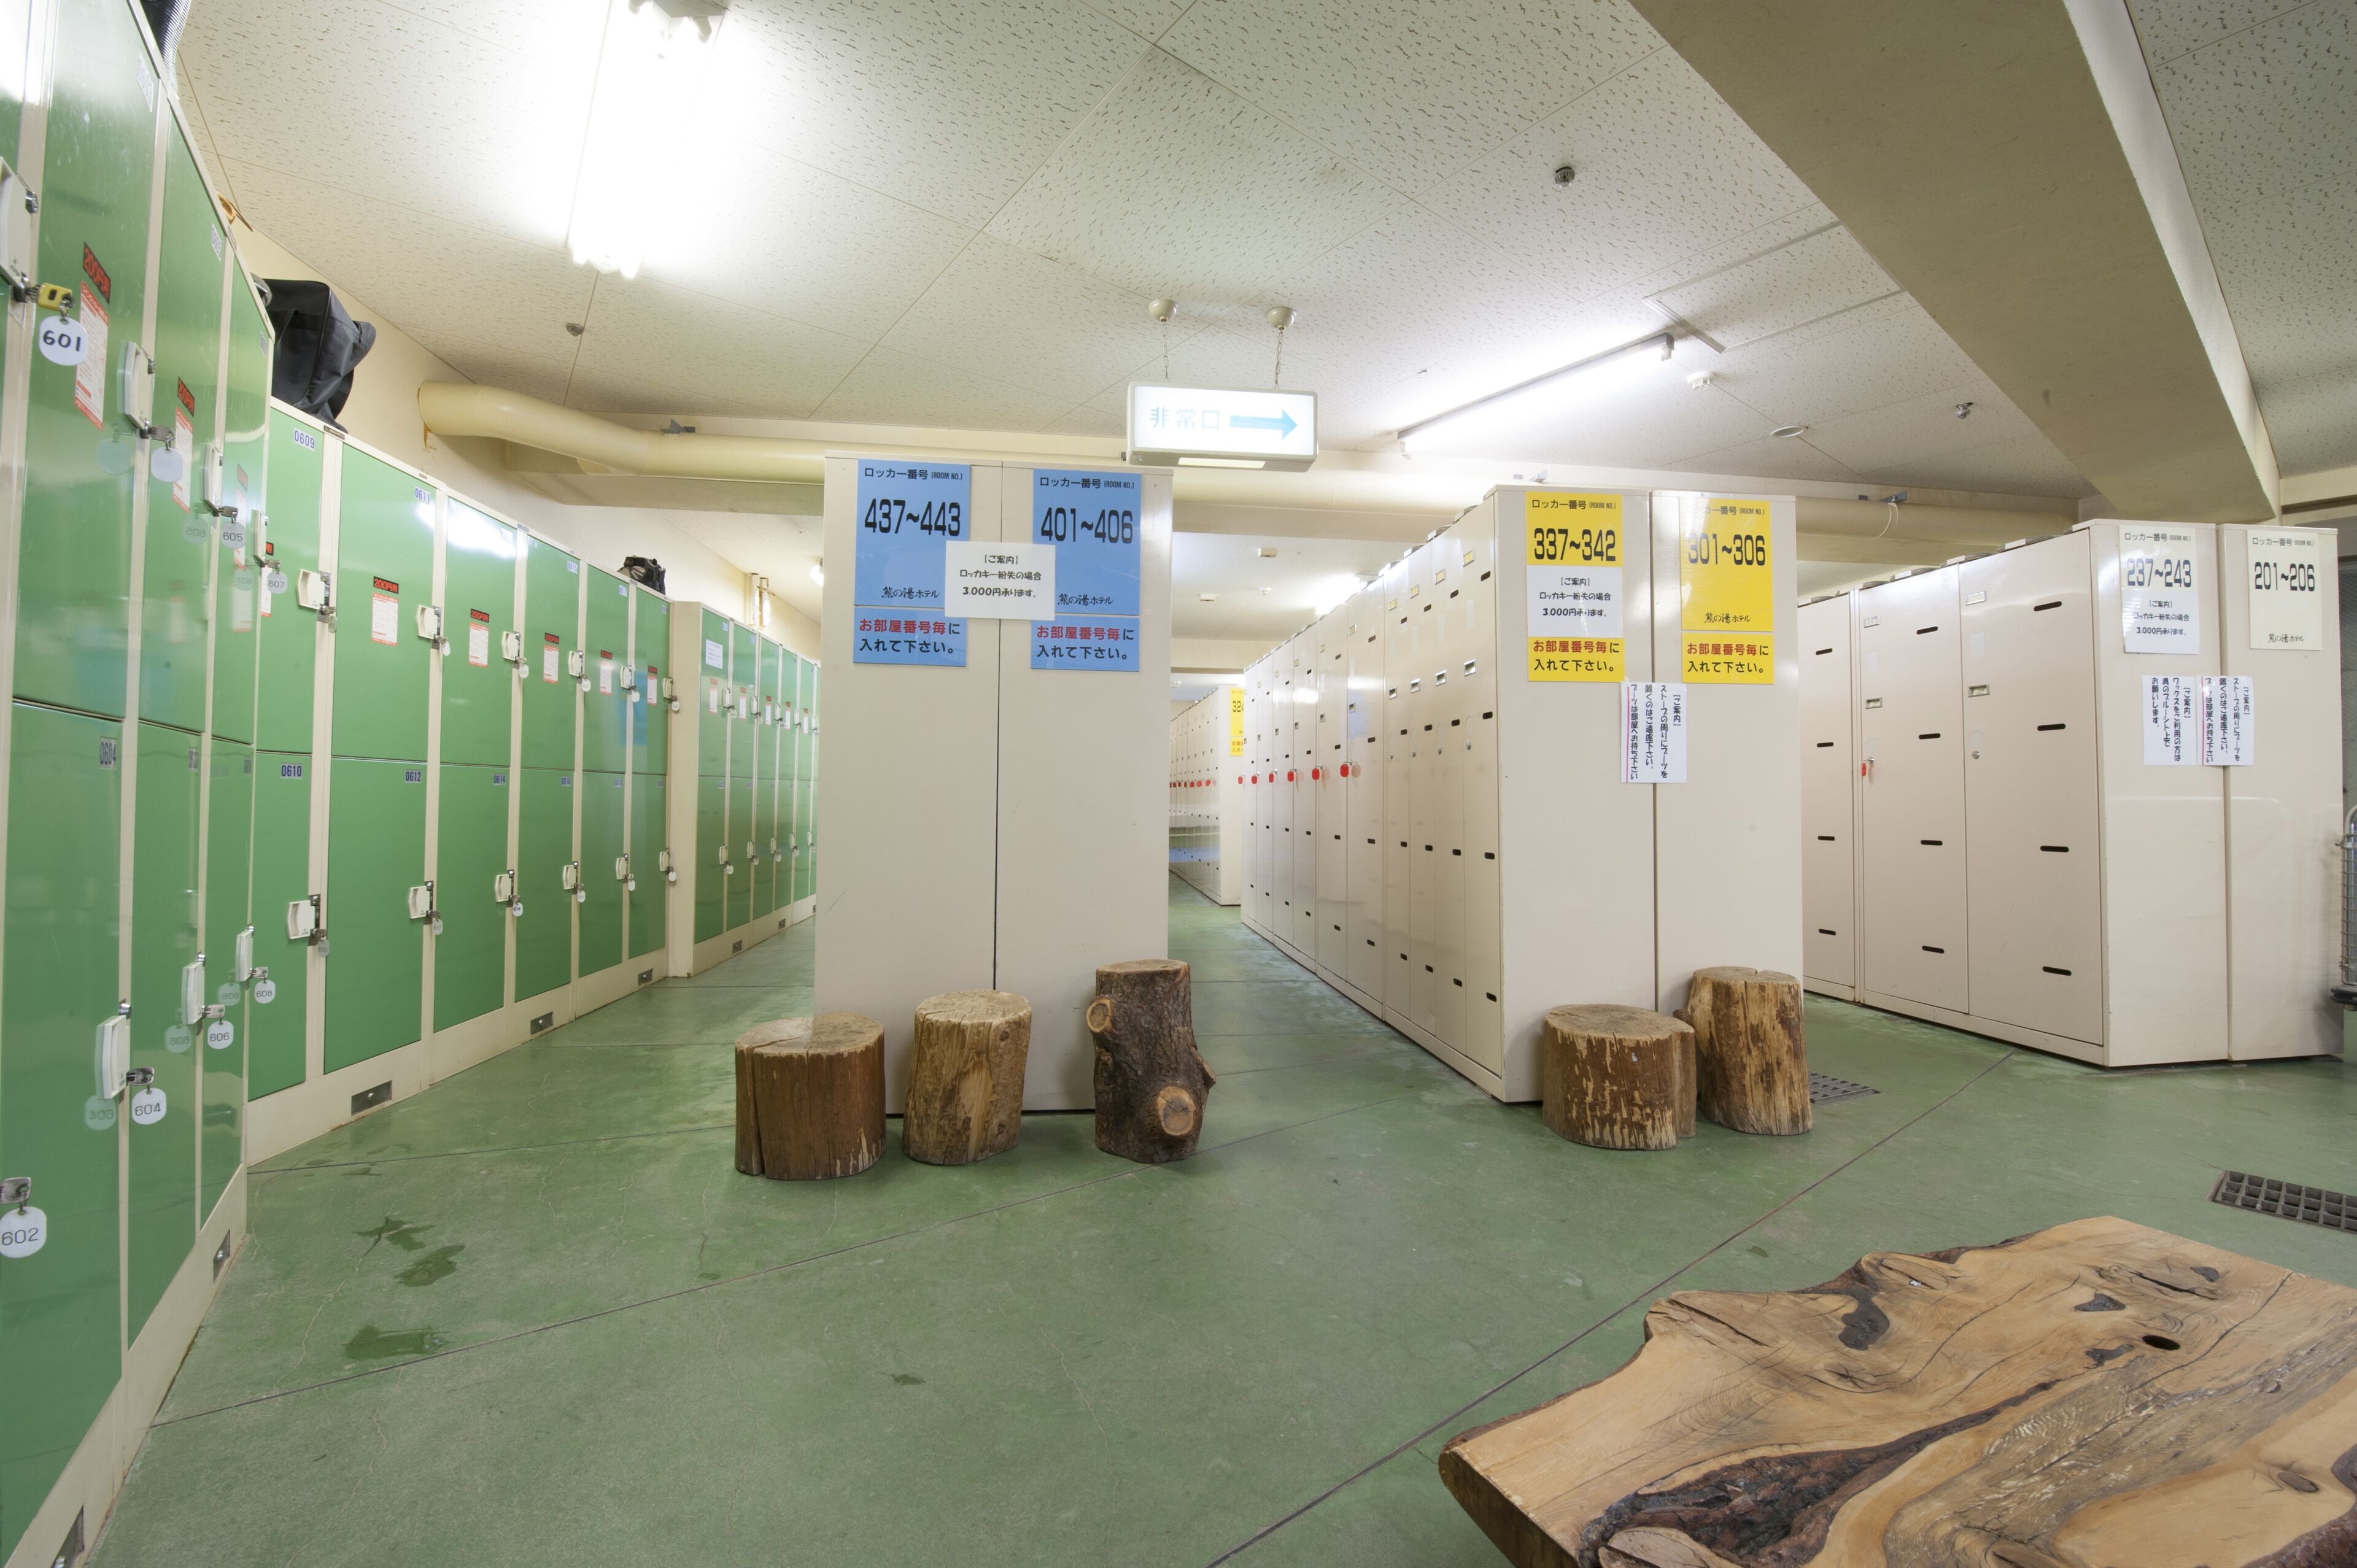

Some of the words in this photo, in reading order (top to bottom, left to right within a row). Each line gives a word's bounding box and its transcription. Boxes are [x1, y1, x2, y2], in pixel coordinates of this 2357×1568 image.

[42, 330, 81, 352] 601
[1150, 406, 1220, 430] 非常口
[294, 430, 315, 449] 0609
[864, 468, 929, 480] ロッカー番号
[1040, 477, 1102, 489] ロッカー番号
[415, 488, 430, 504] 0611
[1531, 499, 1587, 509] ロッカー番号
[222, 531, 243, 542] 605
[2252, 537, 2293, 547] ロッカー番号
[959, 570, 1042, 581] ロッカキー紛失の場合
[268, 580, 285, 589] 607
[881, 586, 940, 600] 熊の湯ホテル
[1057, 593, 1115, 606] 熊の湯ホテル
[1704, 612, 1751, 624] 熊の湯ホテル
[859, 618, 961, 635] お部屋番号毎に
[1037, 625, 1134, 641] お部屋番号毎に
[859, 638, 954, 654] 入れて下さい。
[1036, 644, 1128, 660] 入れて下さい。
[1533, 640, 1620, 654] お部屋番号毎に
[1687, 643, 1769, 656] お部屋番号毎に
[1533, 658, 1614, 672] 入れて下さい。
[1687, 660, 1763, 674] 入れて下さい。
[1630, 684, 1639, 780] ブーツは部屋へお持ち下さい
[1660, 684, 1668, 779] ストーブの周りにブーツを
[99, 741, 117, 767] 0604
[281, 764, 302, 778] 0610
[405, 771, 422, 782] 0612
[493, 774, 506, 784] 0614
[256, 989, 273, 998] 608
[209, 1032, 230, 1042] 606
[134, 1102, 161, 1116] 604
[2, 1227, 39, 1246] 602
